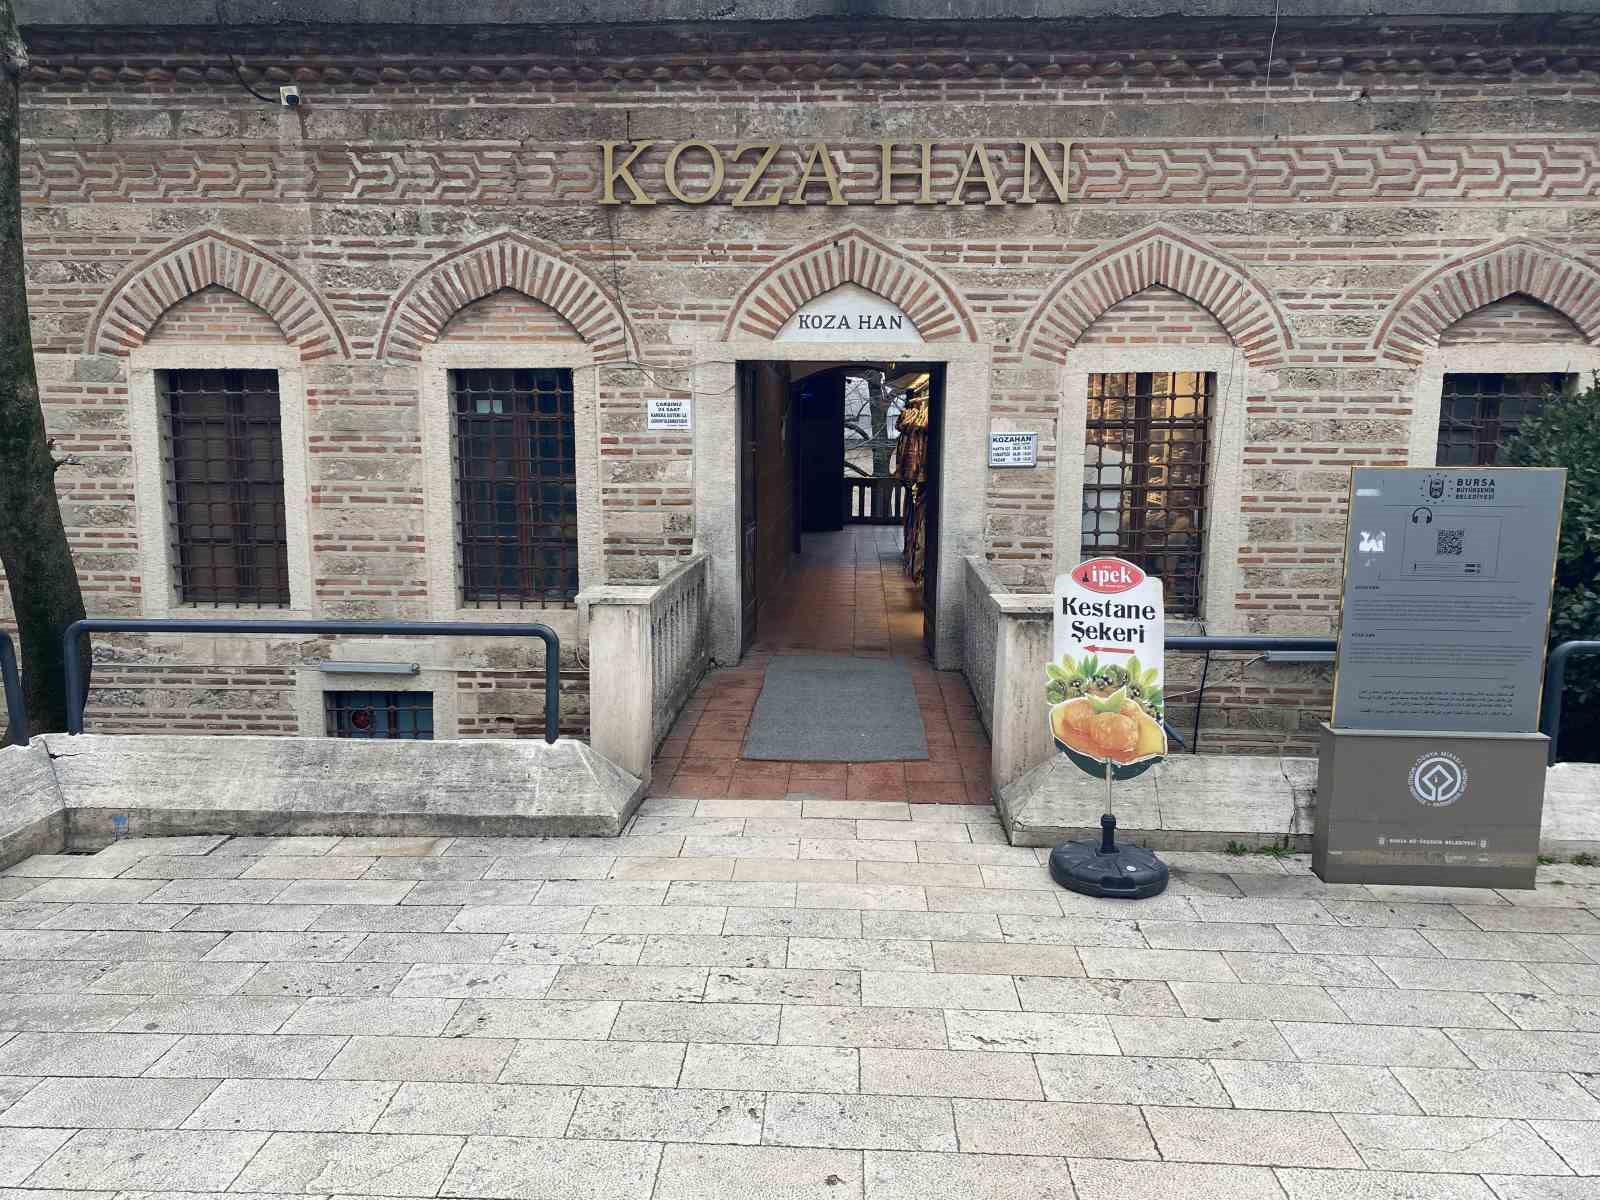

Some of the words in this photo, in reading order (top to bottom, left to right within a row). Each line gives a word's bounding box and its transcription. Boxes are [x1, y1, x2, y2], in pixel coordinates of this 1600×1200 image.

[598, 142, 848, 206] KOZA
[874, 138, 1076, 206] HAN
[798, 313, 850, 330] KOZA
[857, 314, 903, 331] HAN
[1456, 478, 1496, 487] BURSA
[1091, 565, 1132, 586] ipek
[1062, 597, 1156, 620] Kestane
[1071, 620, 1145, 643] Şekeri
